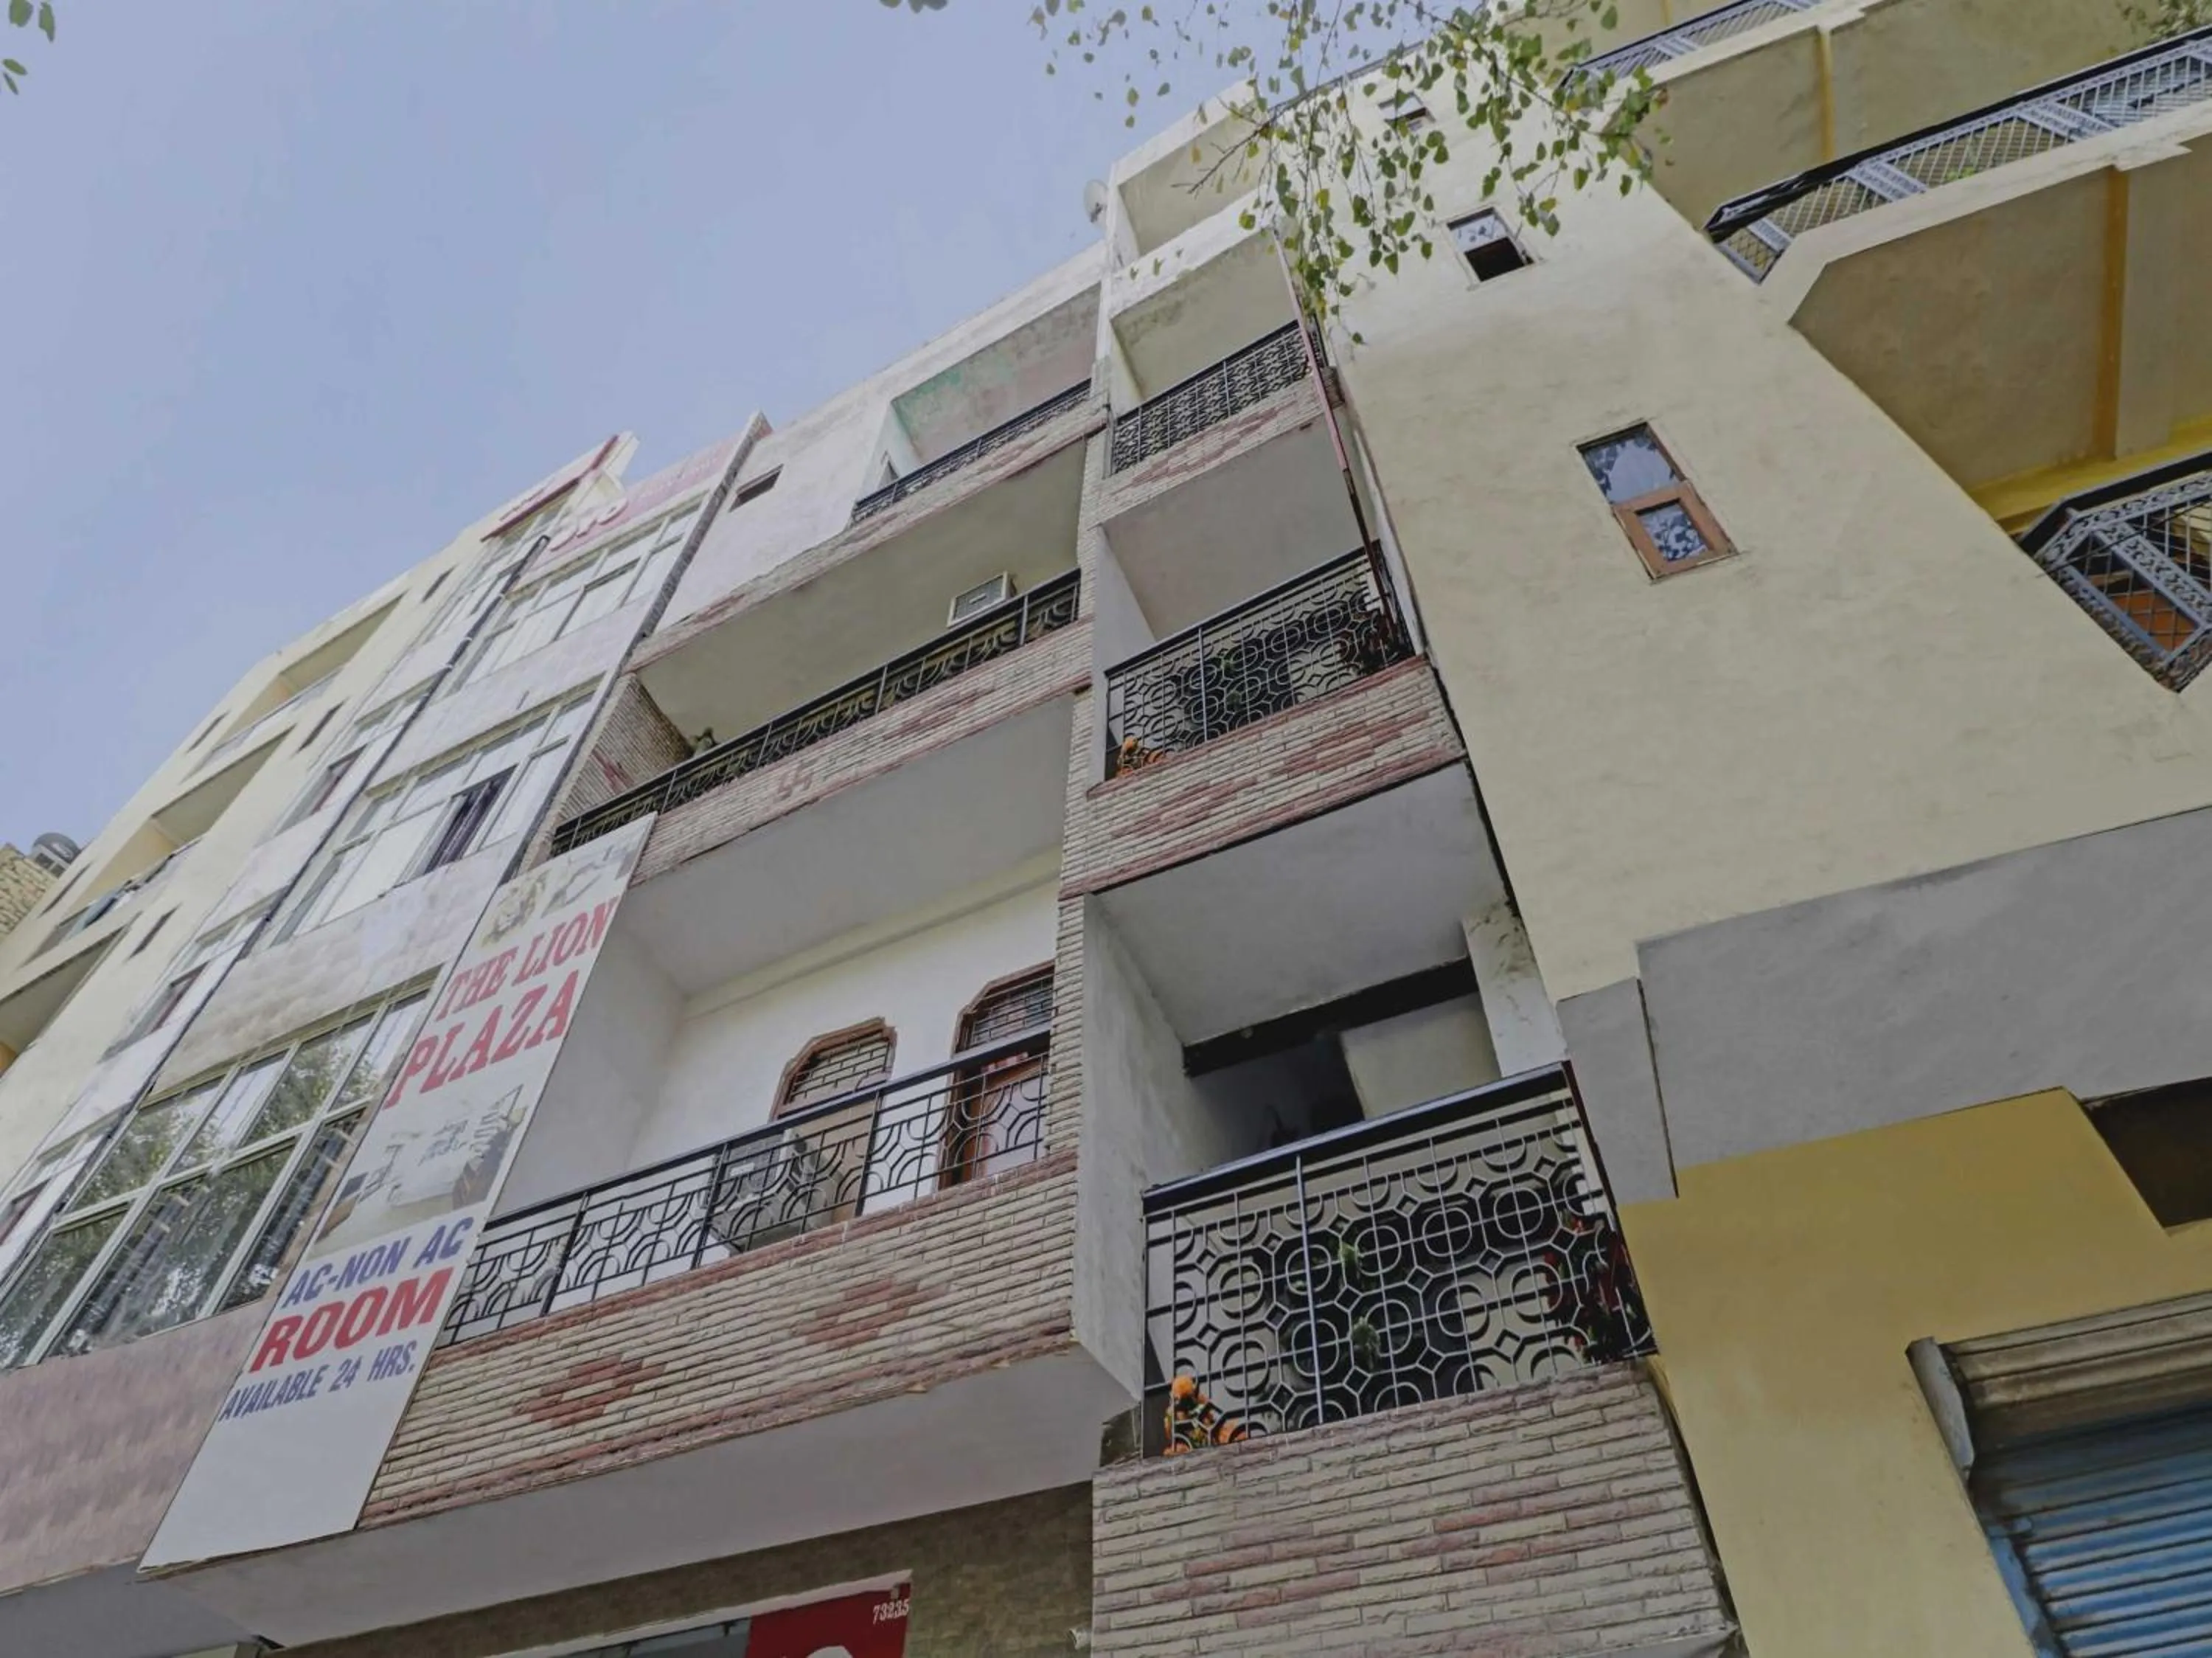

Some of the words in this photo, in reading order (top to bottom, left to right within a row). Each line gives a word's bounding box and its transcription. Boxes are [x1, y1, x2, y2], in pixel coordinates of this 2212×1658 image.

[436, 946, 519, 1021] THE
[512, 895, 620, 986] LION
[383, 969, 580, 1110] PLAZA
[282, 1236, 410, 1308] AC-NON
[412, 1218, 475, 1269] AC
[248, 1268, 453, 1373] ROOM
[218, 1364, 329, 1422] AVAILABLE
[328, 1356, 364, 1392] 24
[367, 1340, 417, 1382] HRS.
